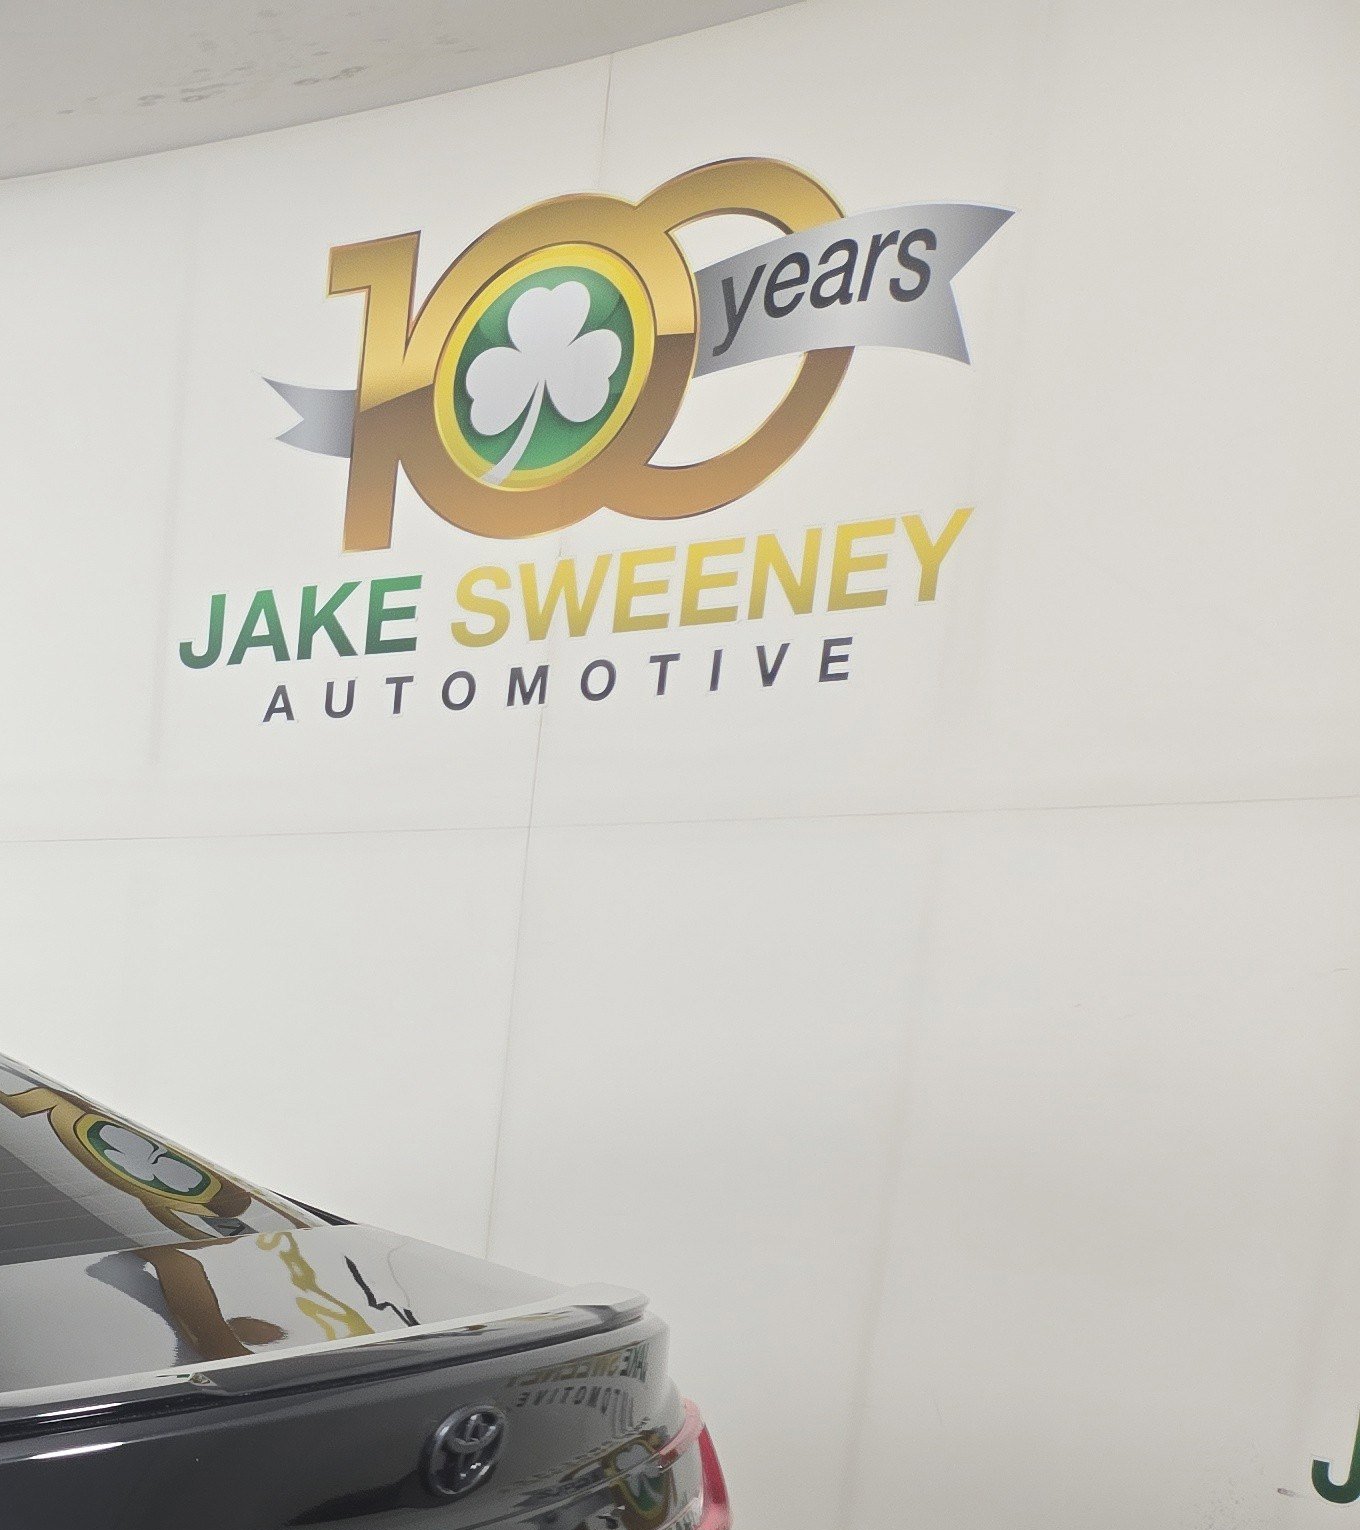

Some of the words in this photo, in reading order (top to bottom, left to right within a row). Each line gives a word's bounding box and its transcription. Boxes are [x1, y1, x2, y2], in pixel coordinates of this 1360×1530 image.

[710, 227, 939, 358] years
[178, 575, 424, 670] JAKE
[449, 507, 975, 648] SWEENEY
[262, 636, 856, 723] AUTOMOTIVE
